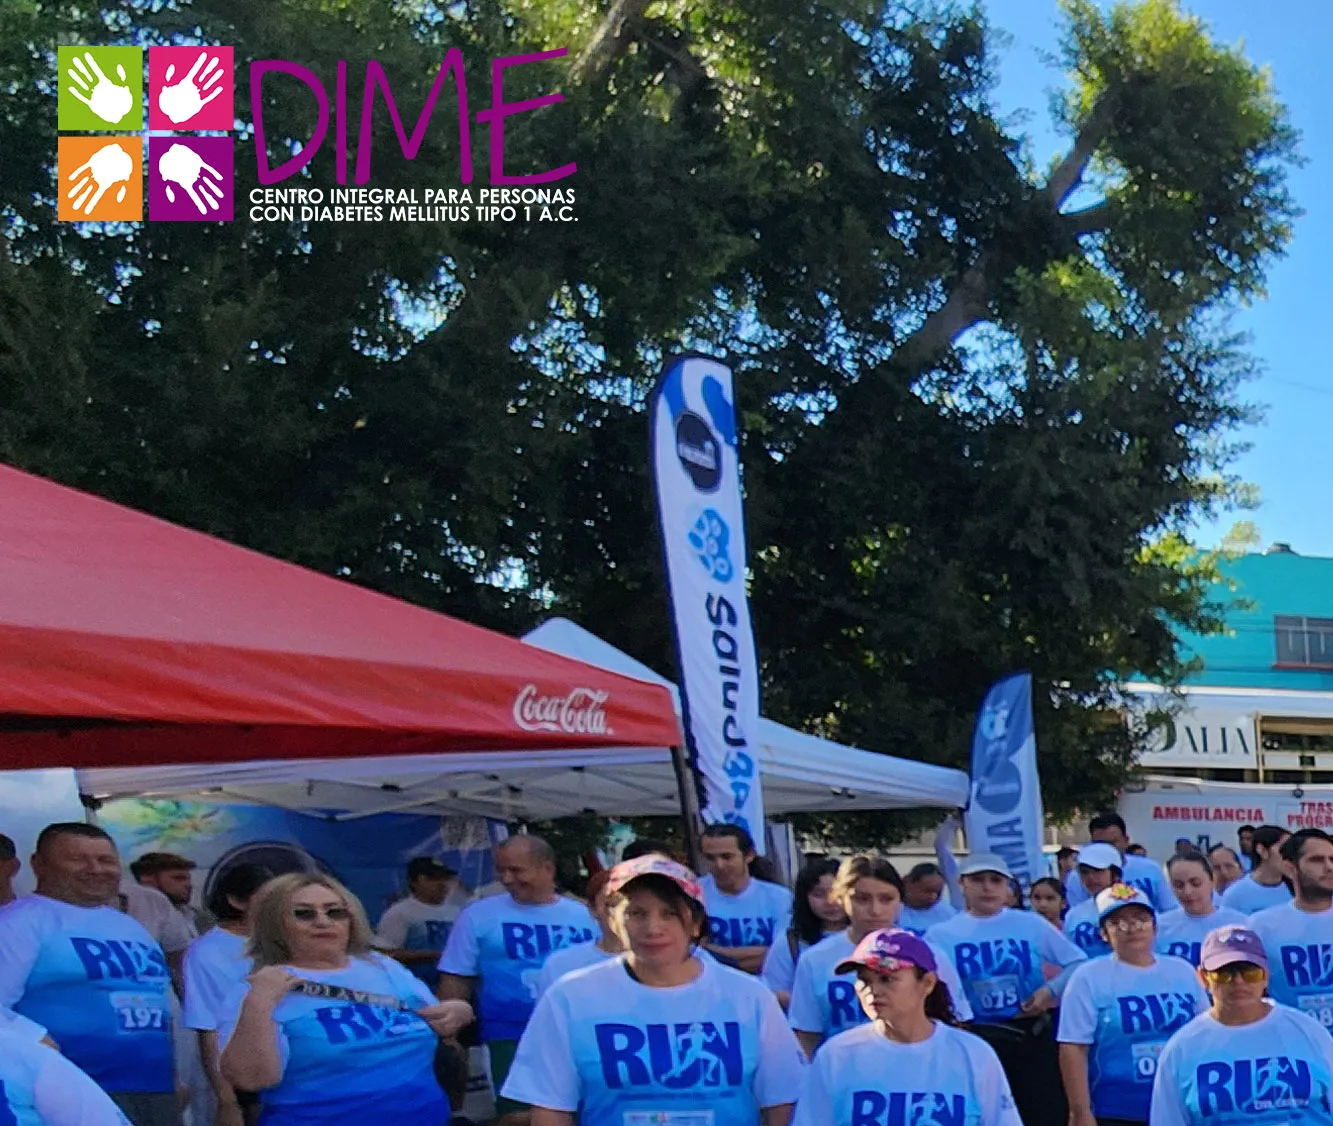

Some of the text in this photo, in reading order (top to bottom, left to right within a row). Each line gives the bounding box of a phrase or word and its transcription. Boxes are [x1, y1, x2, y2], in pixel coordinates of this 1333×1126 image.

[1153, 806, 1264, 822] AMBULANCIA
[954, 938, 1032, 978] RUN
[120, 1007, 164, 1029] 197
[594, 1021, 743, 1090] RUN
[1197, 1056, 1311, 1117] RUN
